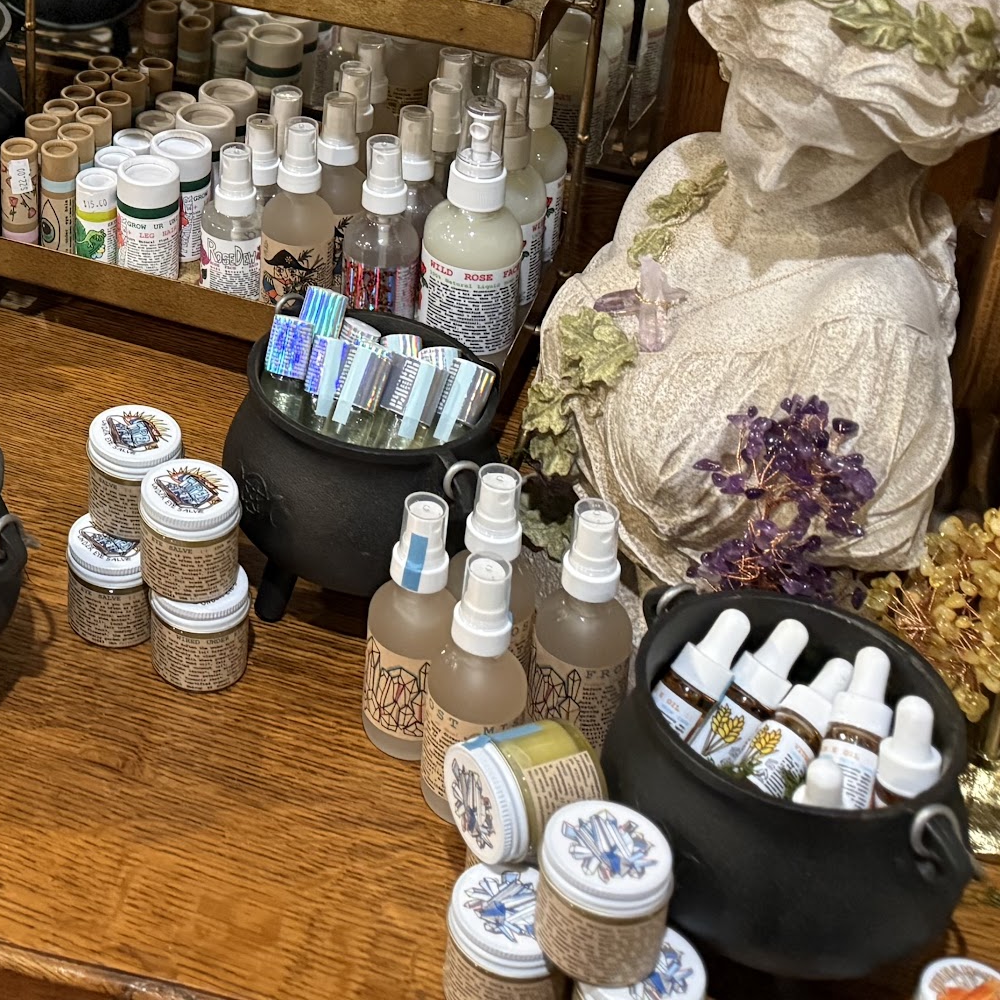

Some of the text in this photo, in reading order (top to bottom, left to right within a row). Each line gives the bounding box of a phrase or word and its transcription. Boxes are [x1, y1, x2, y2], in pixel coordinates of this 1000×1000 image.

[126, 221, 147, 230] GROW
[430, 259, 454, 277] WILD
[464, 273, 494, 282] ROSE
[445, 278, 473, 289] Natural
[477, 282, 501, 290] Liquid
[164, 500, 176, 509] EYE
[168, 545, 193, 555] SALVE
[93, 551, 105, 560] EYE
[176, 634, 230, 645] WIRED UNDER
[585, 662, 624, 679] FRO
